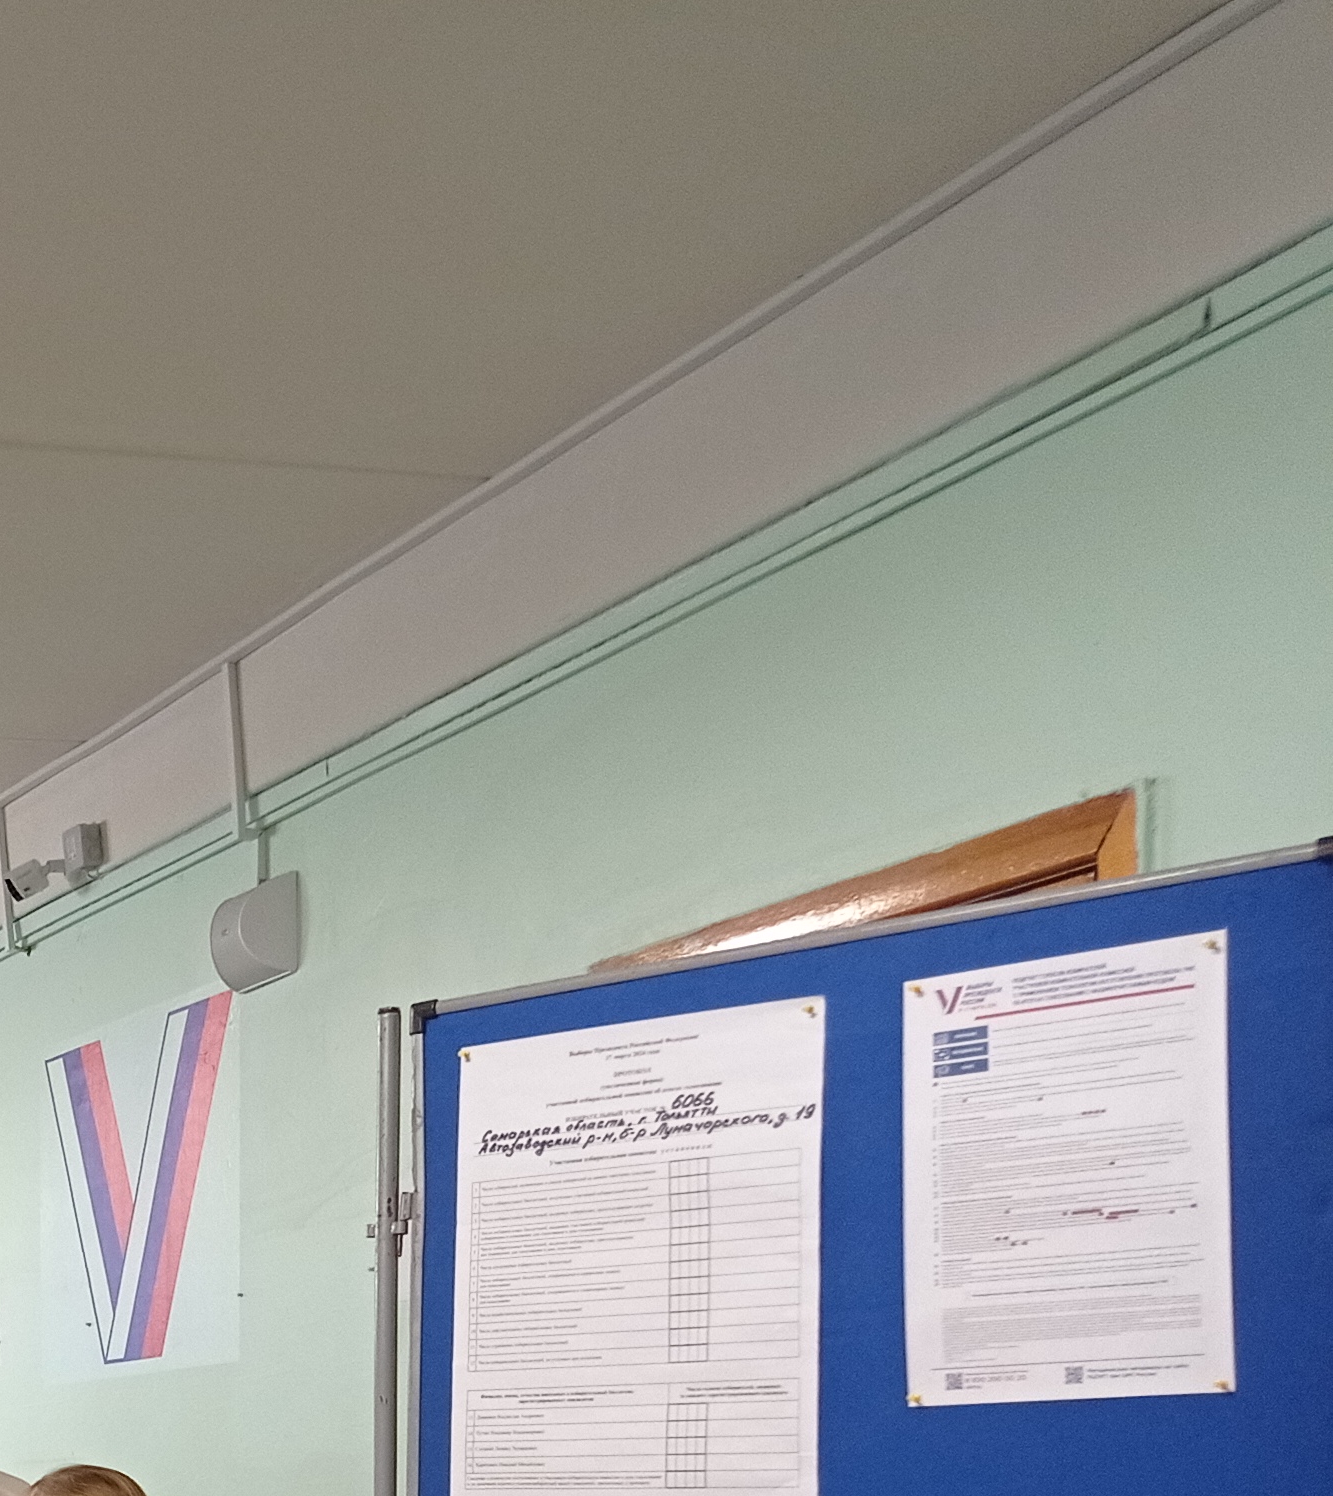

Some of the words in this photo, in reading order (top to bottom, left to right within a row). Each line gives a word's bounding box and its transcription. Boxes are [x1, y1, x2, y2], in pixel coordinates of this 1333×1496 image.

[654, 1105, 719, 1123] Тольятти
[671, 1091, 715, 1110] 6066
[478, 1133, 582, 1157] Автозаводский
[796, 1102, 817, 1120] 19
[45, 990, 233, 1364] V
